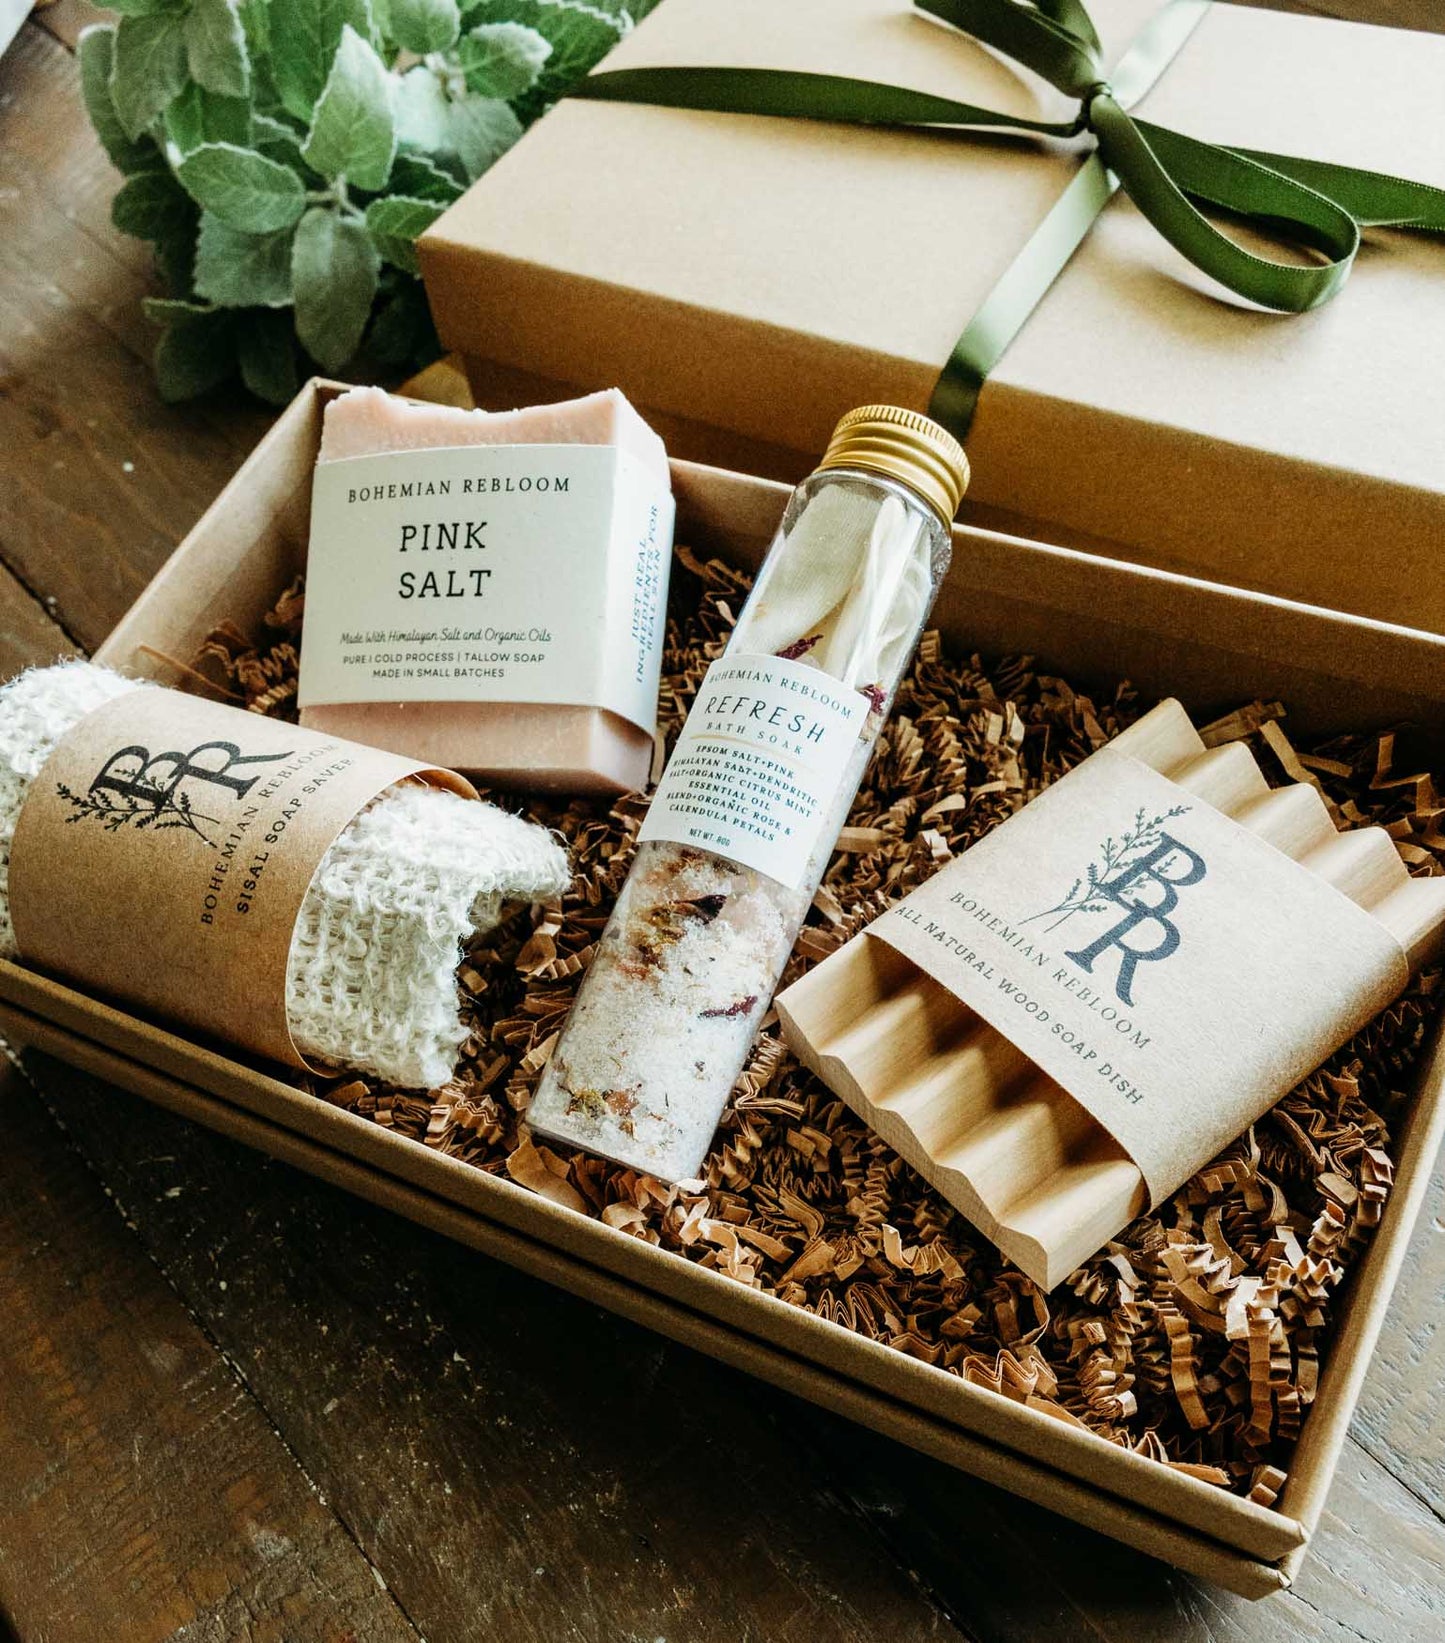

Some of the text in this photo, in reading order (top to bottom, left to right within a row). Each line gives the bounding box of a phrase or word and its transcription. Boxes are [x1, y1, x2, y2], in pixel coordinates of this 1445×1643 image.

[348, 477, 570, 503] BOHEMIAN REBLOOM
[399, 521, 488, 552] PINK
[398, 569, 492, 599] SALT
[340, 631, 364, 645] Made
[388, 629, 438, 645] Himalayan
[440, 628, 461, 641] Salt
[463, 628, 482, 641] and
[484, 627, 527, 645] Organic
[528, 628, 551, 642] Oils
[343, 654, 367, 665] PURE
[374, 653, 403, 663] COLD
[405, 652, 454, 662] PROCESS
[464, 652, 510, 662] TALLOW
[513, 653, 545, 663] SOAP
[373, 668, 505, 678] MADE IN SMALL BATCHES
[709, 669, 853, 720] BOHEMIAN REBLOOM
[704, 695, 826, 744] REFRESH
[696, 745, 728, 755] EPSOM
[706, 721, 803, 755] BATH SOAK
[688, 780, 772, 811] ESSENTIAL OIL
[739, 779, 783, 801] CITRUS
[785, 799, 812, 818] MINT
[201, 743, 342, 925] BOHEMIAN REBLOOM
[236, 757, 355, 914] SISAL SOAP SAVER
[669, 803, 776, 842] CALENDULA PETALS
[688, 828, 702, 838] NET
[753, 811, 781, 831] ROSE
[949, 890, 1152, 1050] BOHEMIAN REBLOOM
[894, 904, 1146, 1107] ALL NATURAL WOOD SOAP DISH
